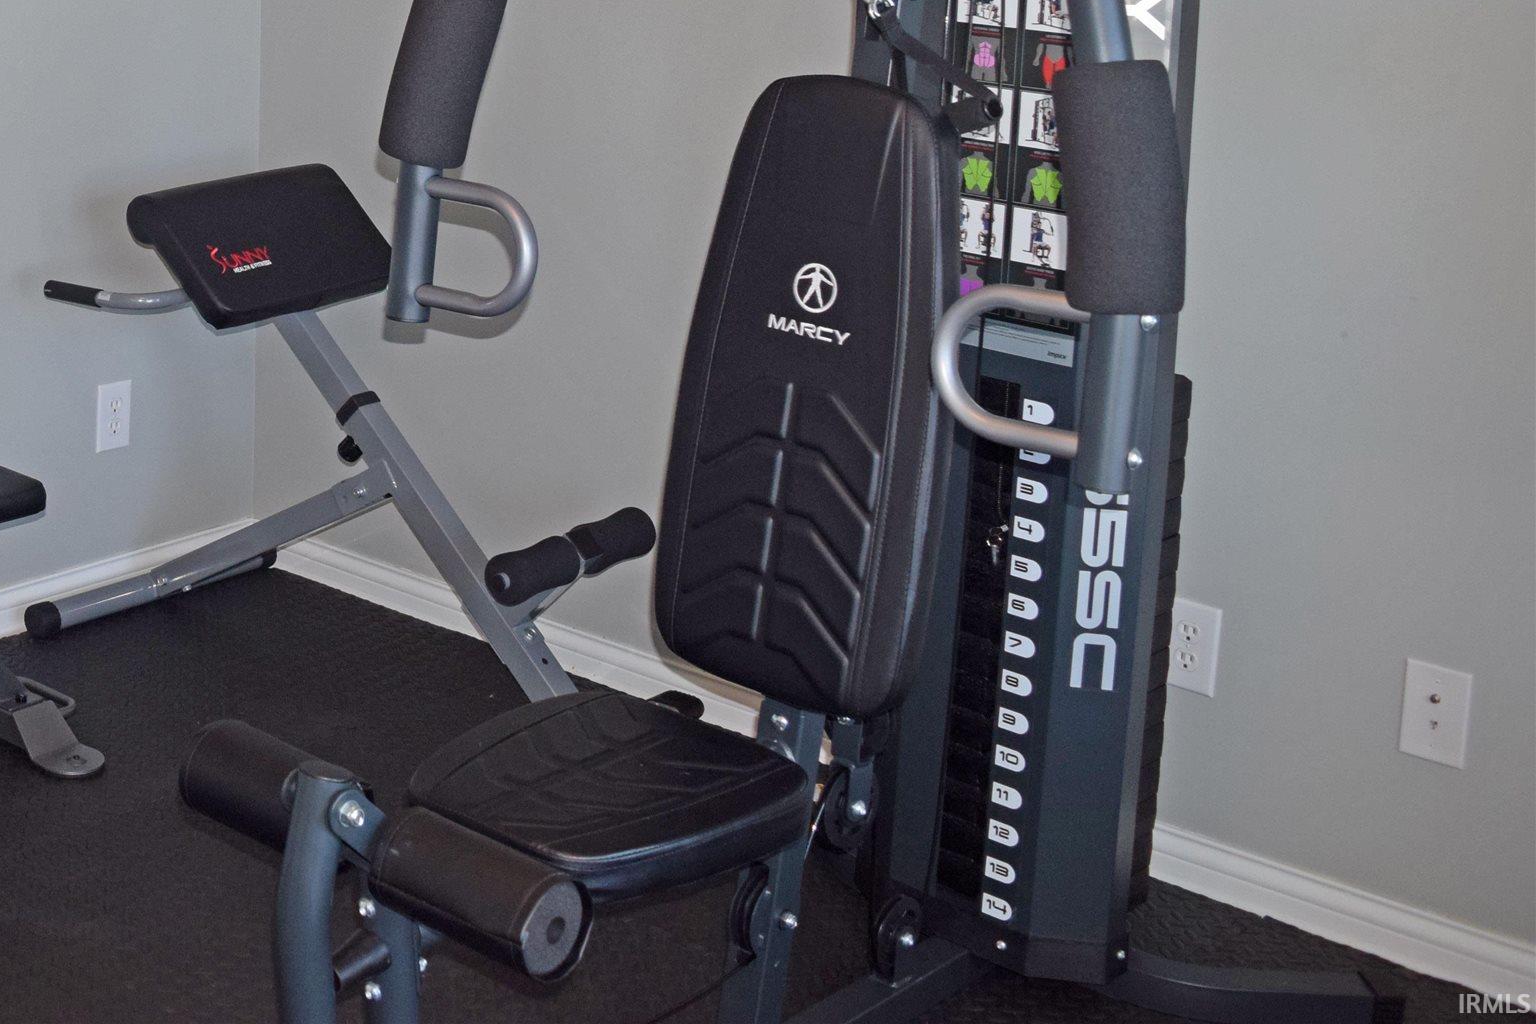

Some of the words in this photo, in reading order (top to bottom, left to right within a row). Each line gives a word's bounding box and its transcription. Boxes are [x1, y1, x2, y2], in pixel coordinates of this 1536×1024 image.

[206, 244, 270, 274] SUNNY
[767, 313, 851, 346] MARCY
[1027, 404, 1034, 416] 1
[1019, 482, 1034, 496] 3
[1017, 521, 1033, 535] 4
[1013, 559, 1029, 574] 5
[1069, 489, 1130, 691] 5SC
[1011, 598, 1026, 612] 6
[1008, 636, 1023, 649] 7
[1004, 674, 1019, 689] 8
[1001, 712, 1017, 726] 9
[999, 750, 1019, 766] 10
[996, 787, 1010, 801] 11
[992, 825, 1010, 840] 12
[989, 862, 1010, 878] 13
[985, 898, 1007, 915] 14
